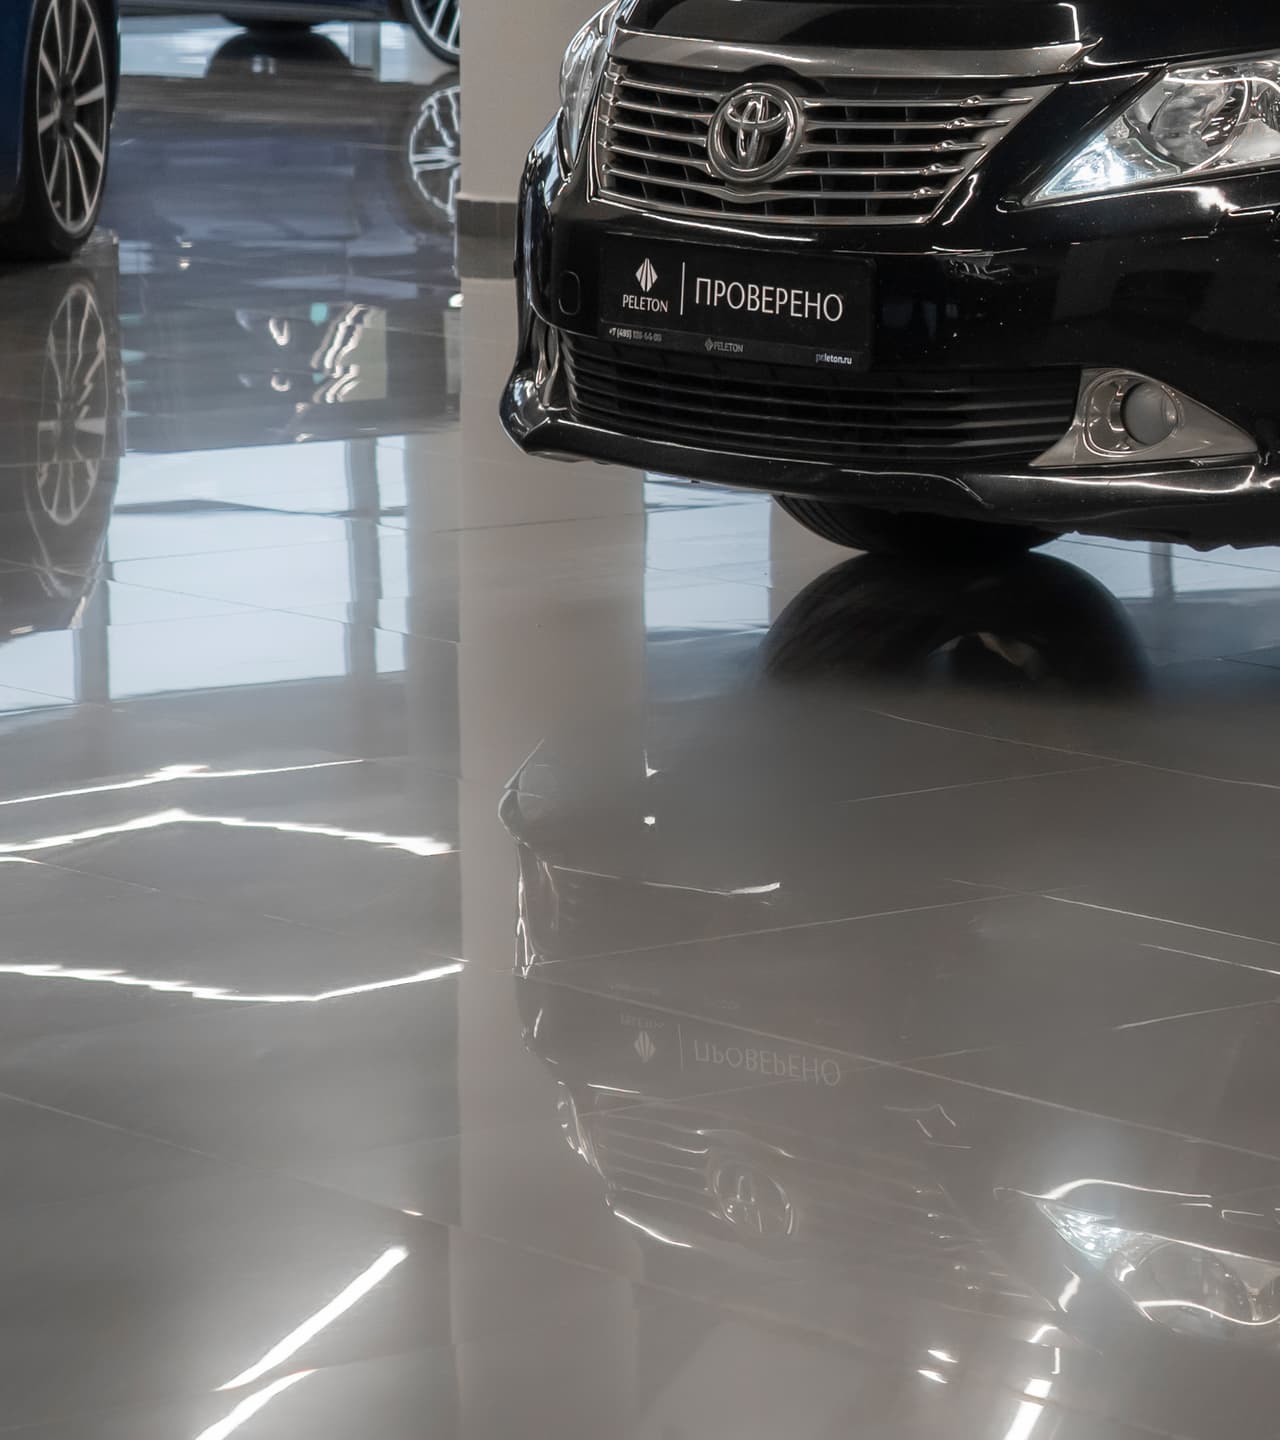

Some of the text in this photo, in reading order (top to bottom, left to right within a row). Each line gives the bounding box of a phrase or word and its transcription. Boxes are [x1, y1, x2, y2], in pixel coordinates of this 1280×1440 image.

[622, 294, 669, 313] PELETON
[695, 277, 844, 322] ПРОВЕРЕНО
[713, 341, 744, 353] PELETON
[815, 352, 852, 365] peleton.ru
